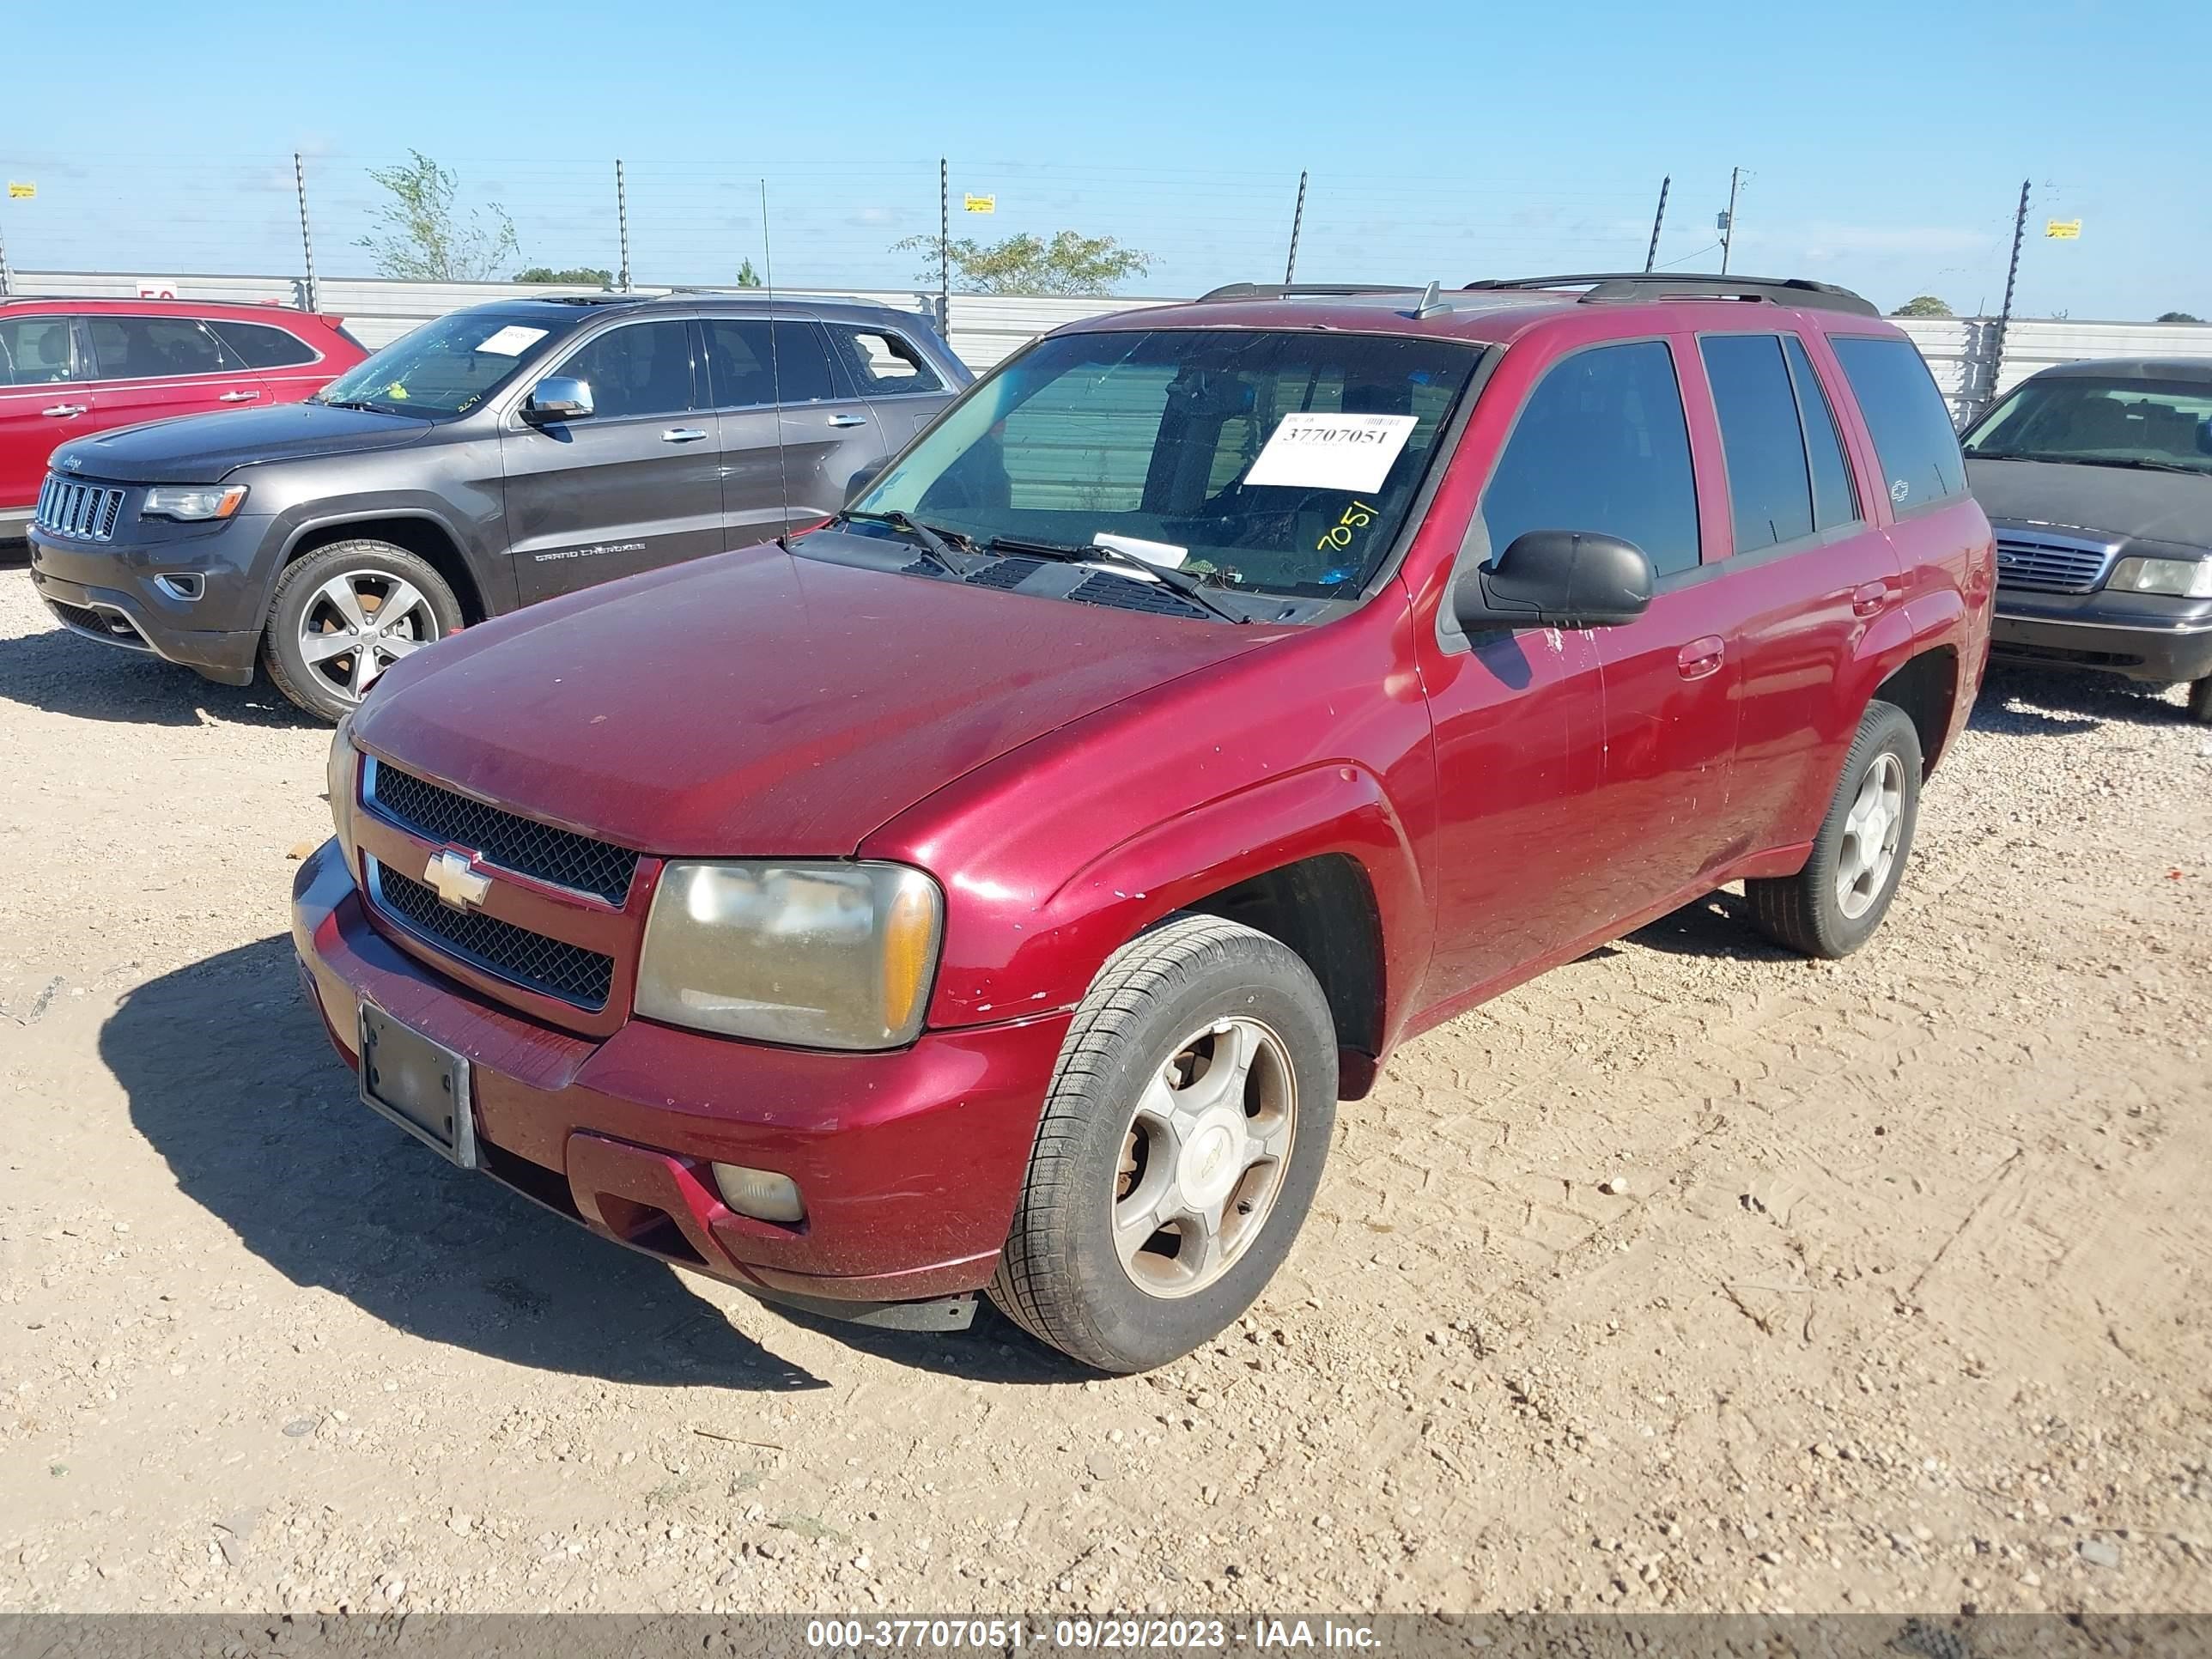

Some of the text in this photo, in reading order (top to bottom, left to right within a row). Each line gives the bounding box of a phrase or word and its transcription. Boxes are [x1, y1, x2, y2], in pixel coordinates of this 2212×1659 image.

[1283, 428, 1389, 445] 37707051
[1317, 501, 1379, 551] 7051
[535, 550, 579, 562] GRAND
